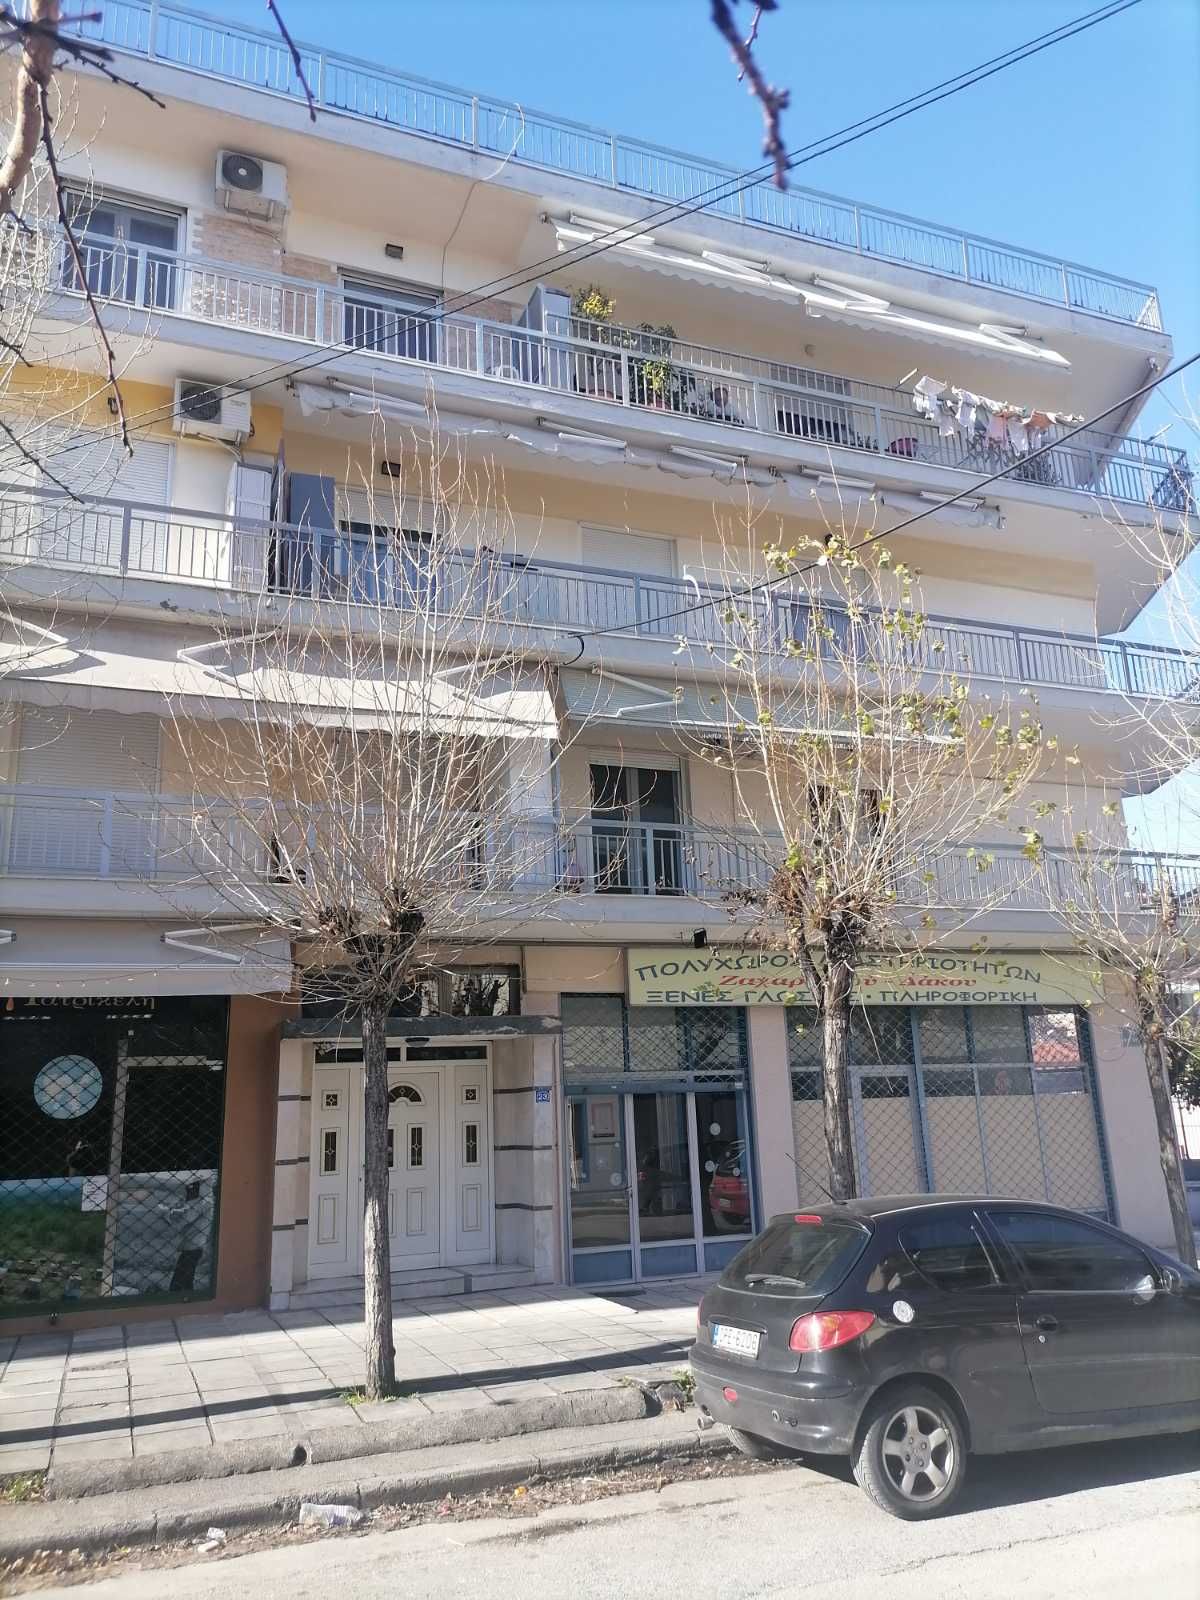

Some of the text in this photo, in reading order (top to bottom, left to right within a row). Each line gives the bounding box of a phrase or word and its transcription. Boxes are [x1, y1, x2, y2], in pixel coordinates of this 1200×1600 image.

[819, 953, 1041, 983] ΣΤΗΡΙΟΤΗΤΩΝ
[646, 990, 1038, 1003] ΞΕΝΕΣ ΓΛΩΣΣ ΠΛΗΡΟΦΟΡΙΚΗ
